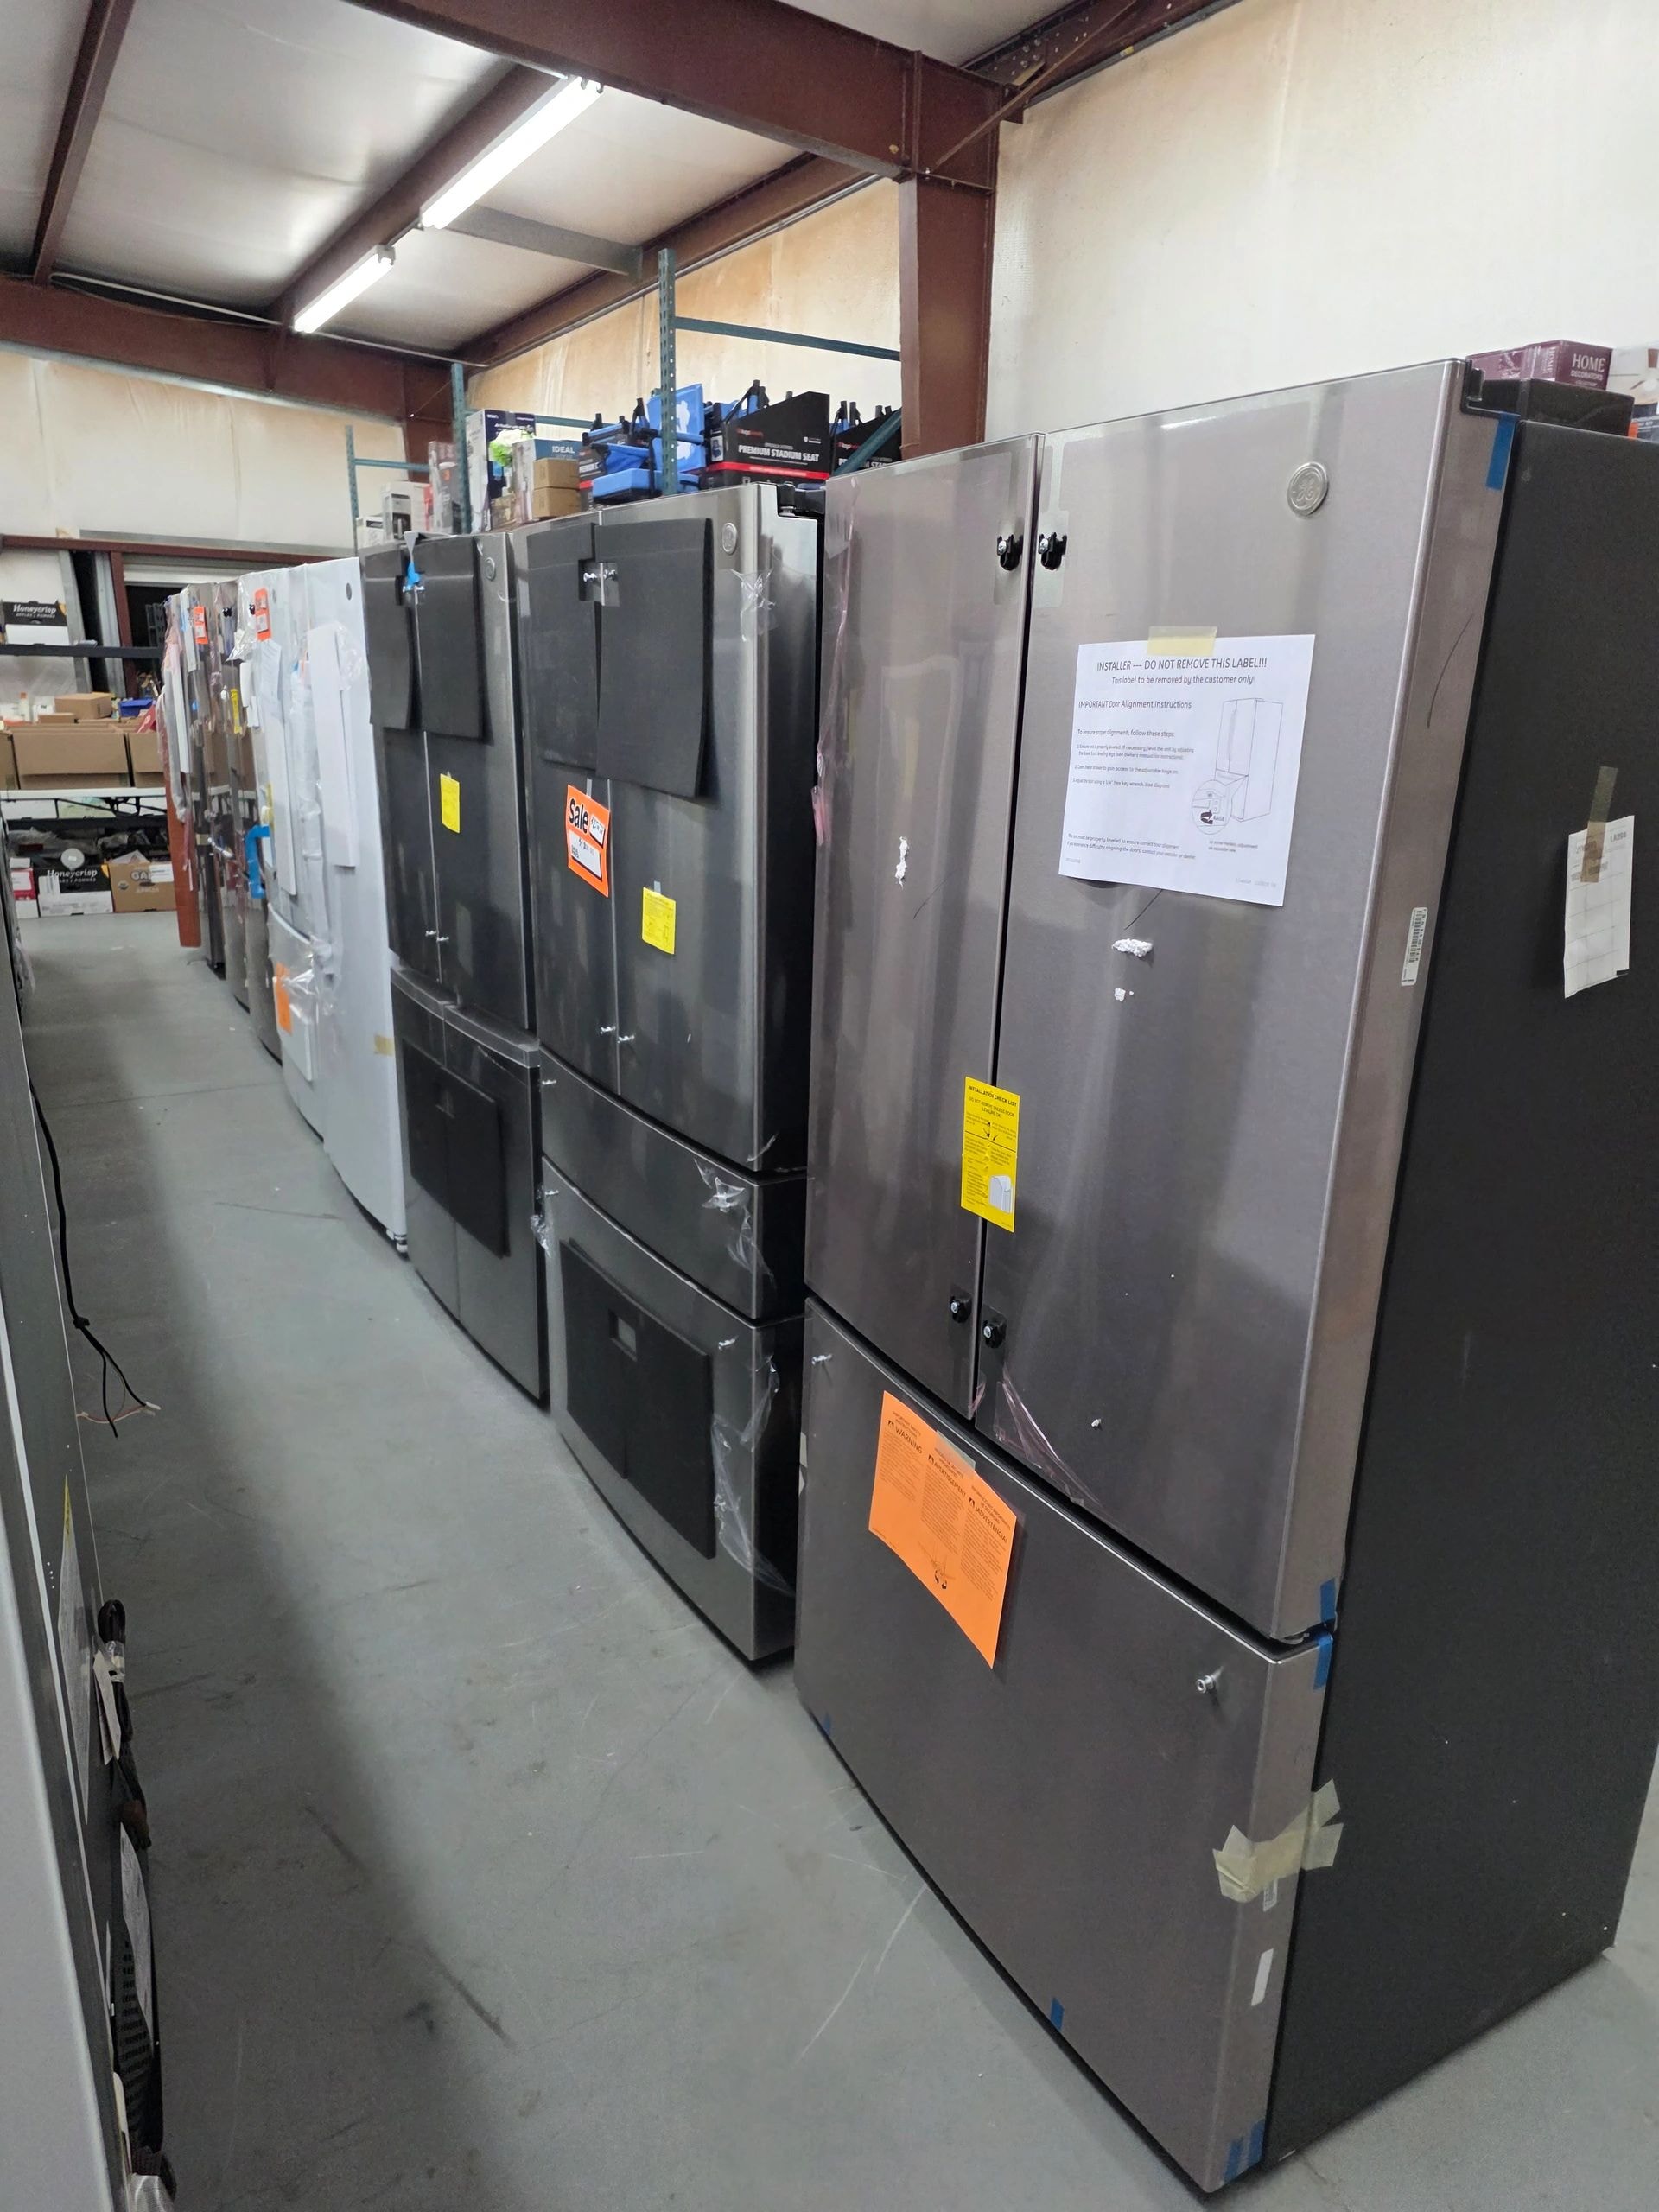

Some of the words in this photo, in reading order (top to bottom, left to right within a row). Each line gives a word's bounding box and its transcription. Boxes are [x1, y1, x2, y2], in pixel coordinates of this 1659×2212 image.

[1572, 353, 1606, 373] HOME
[551, 445, 575, 454] IDEAL
[738, 444, 771, 457] PREMIUM
[771, 448, 801, 461] STADIUM
[802, 452, 820, 462] SEAT
[1096, 660, 1132, 671] INSTALLER
[1144, 659, 1157, 670] DO
[1158, 658, 1175, 670] NOT
[1176, 658, 1210, 669] REMOVE
[1211, 658, 1230, 669] THIS
[1231, 657, 1268, 668] LABEL!!!
[1138, 676, 1145, 684] to
[1146, 675, 1154, 684] be
[1154, 674, 1183, 684] removed
[1183, 674, 1192, 685] by
[1192, 674, 1204, 683] the
[1205, 675, 1237, 683] customer
[1078, 700, 1108, 709] IMPORTANT
[1121, 699, 1154, 710] Alignment
[1154, 700, 1192, 709] Instructions
[569, 798, 588, 834] Sale
[46, 869, 98, 879] Honeycrisp
[896, 1426, 923, 1454] WARNING
